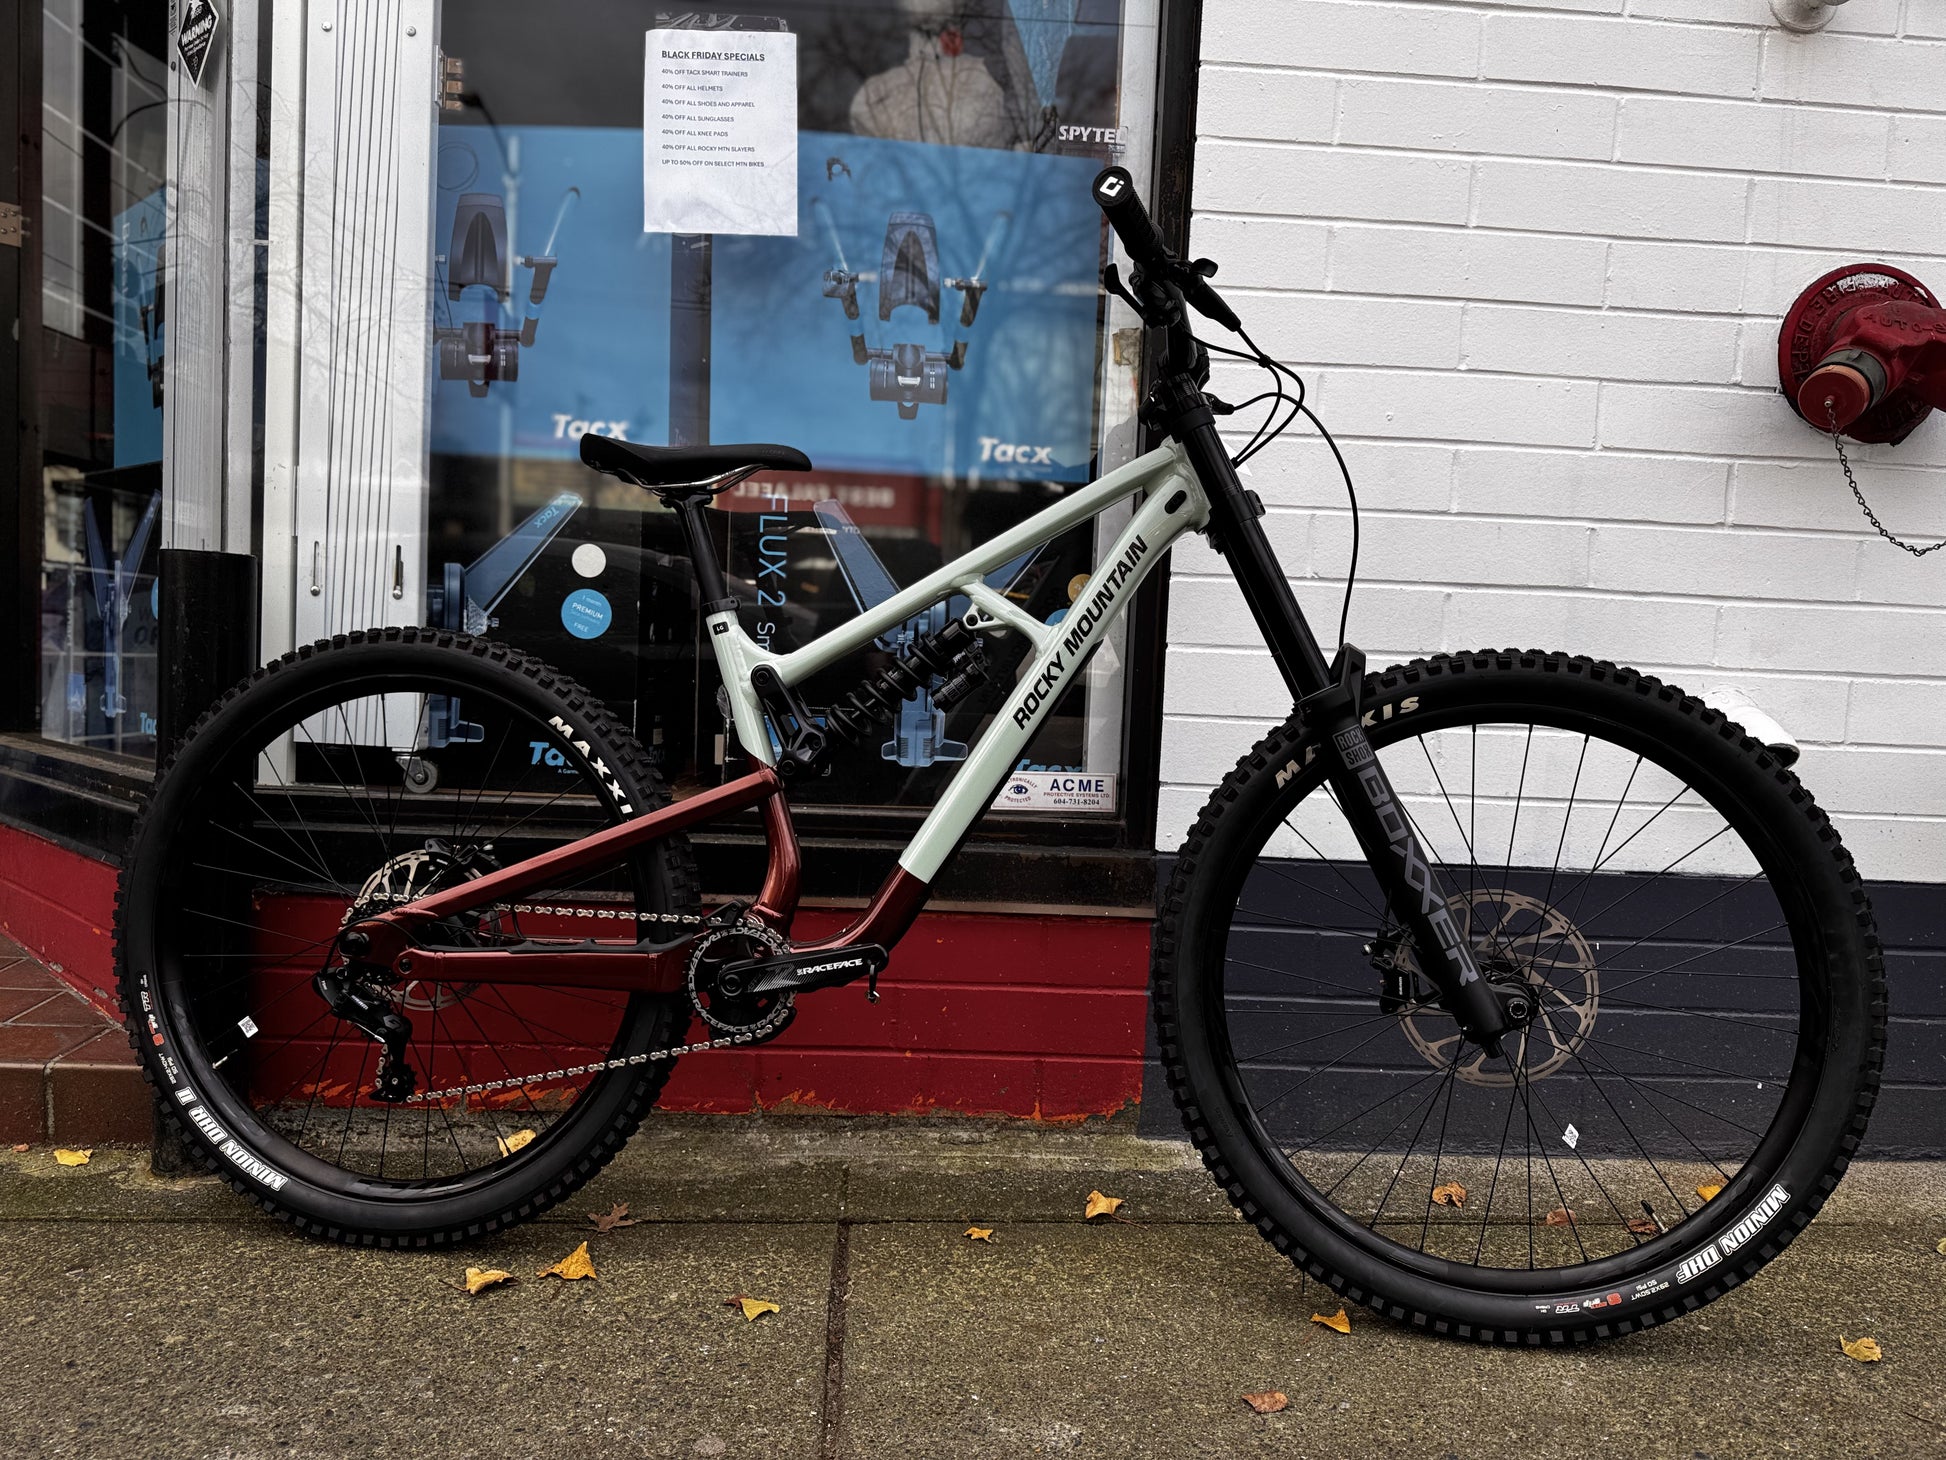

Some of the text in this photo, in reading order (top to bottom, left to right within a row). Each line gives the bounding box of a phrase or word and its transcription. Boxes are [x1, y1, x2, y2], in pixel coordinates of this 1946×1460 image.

[181, 14, 213, 46] WARNING
[661, 50, 765, 62] BLACK FRIDAY SPECIALS
[551, 414, 630, 442] Tacx
[978, 436, 1053, 465] Tacx
[533, 506, 560, 529] Tacx
[757, 494, 790, 580] FLUX
[756, 589, 787, 607] 2
[571, 602, 604, 621] PREMIUM
[574, 622, 590, 633] FREE
[1013, 534, 1150, 731] ROCKY MOUNTAIN
[1335, 728, 1366, 752] ROCK
[547, 714, 634, 815] MAXXI
[1344, 744, 1372, 766] SHOX
[1050, 778, 1105, 793] ACME
[1004, 795, 1032, 803] PROTECTED
[1053, 798, 1100, 806] 604-731-8204
[1356, 764, 1480, 988] BOXXER
[803, 957, 863, 975] RACEFACE
[174, 1086, 288, 1192] MINION DHR II
[1676, 1183, 1792, 1285] MINION DHF
